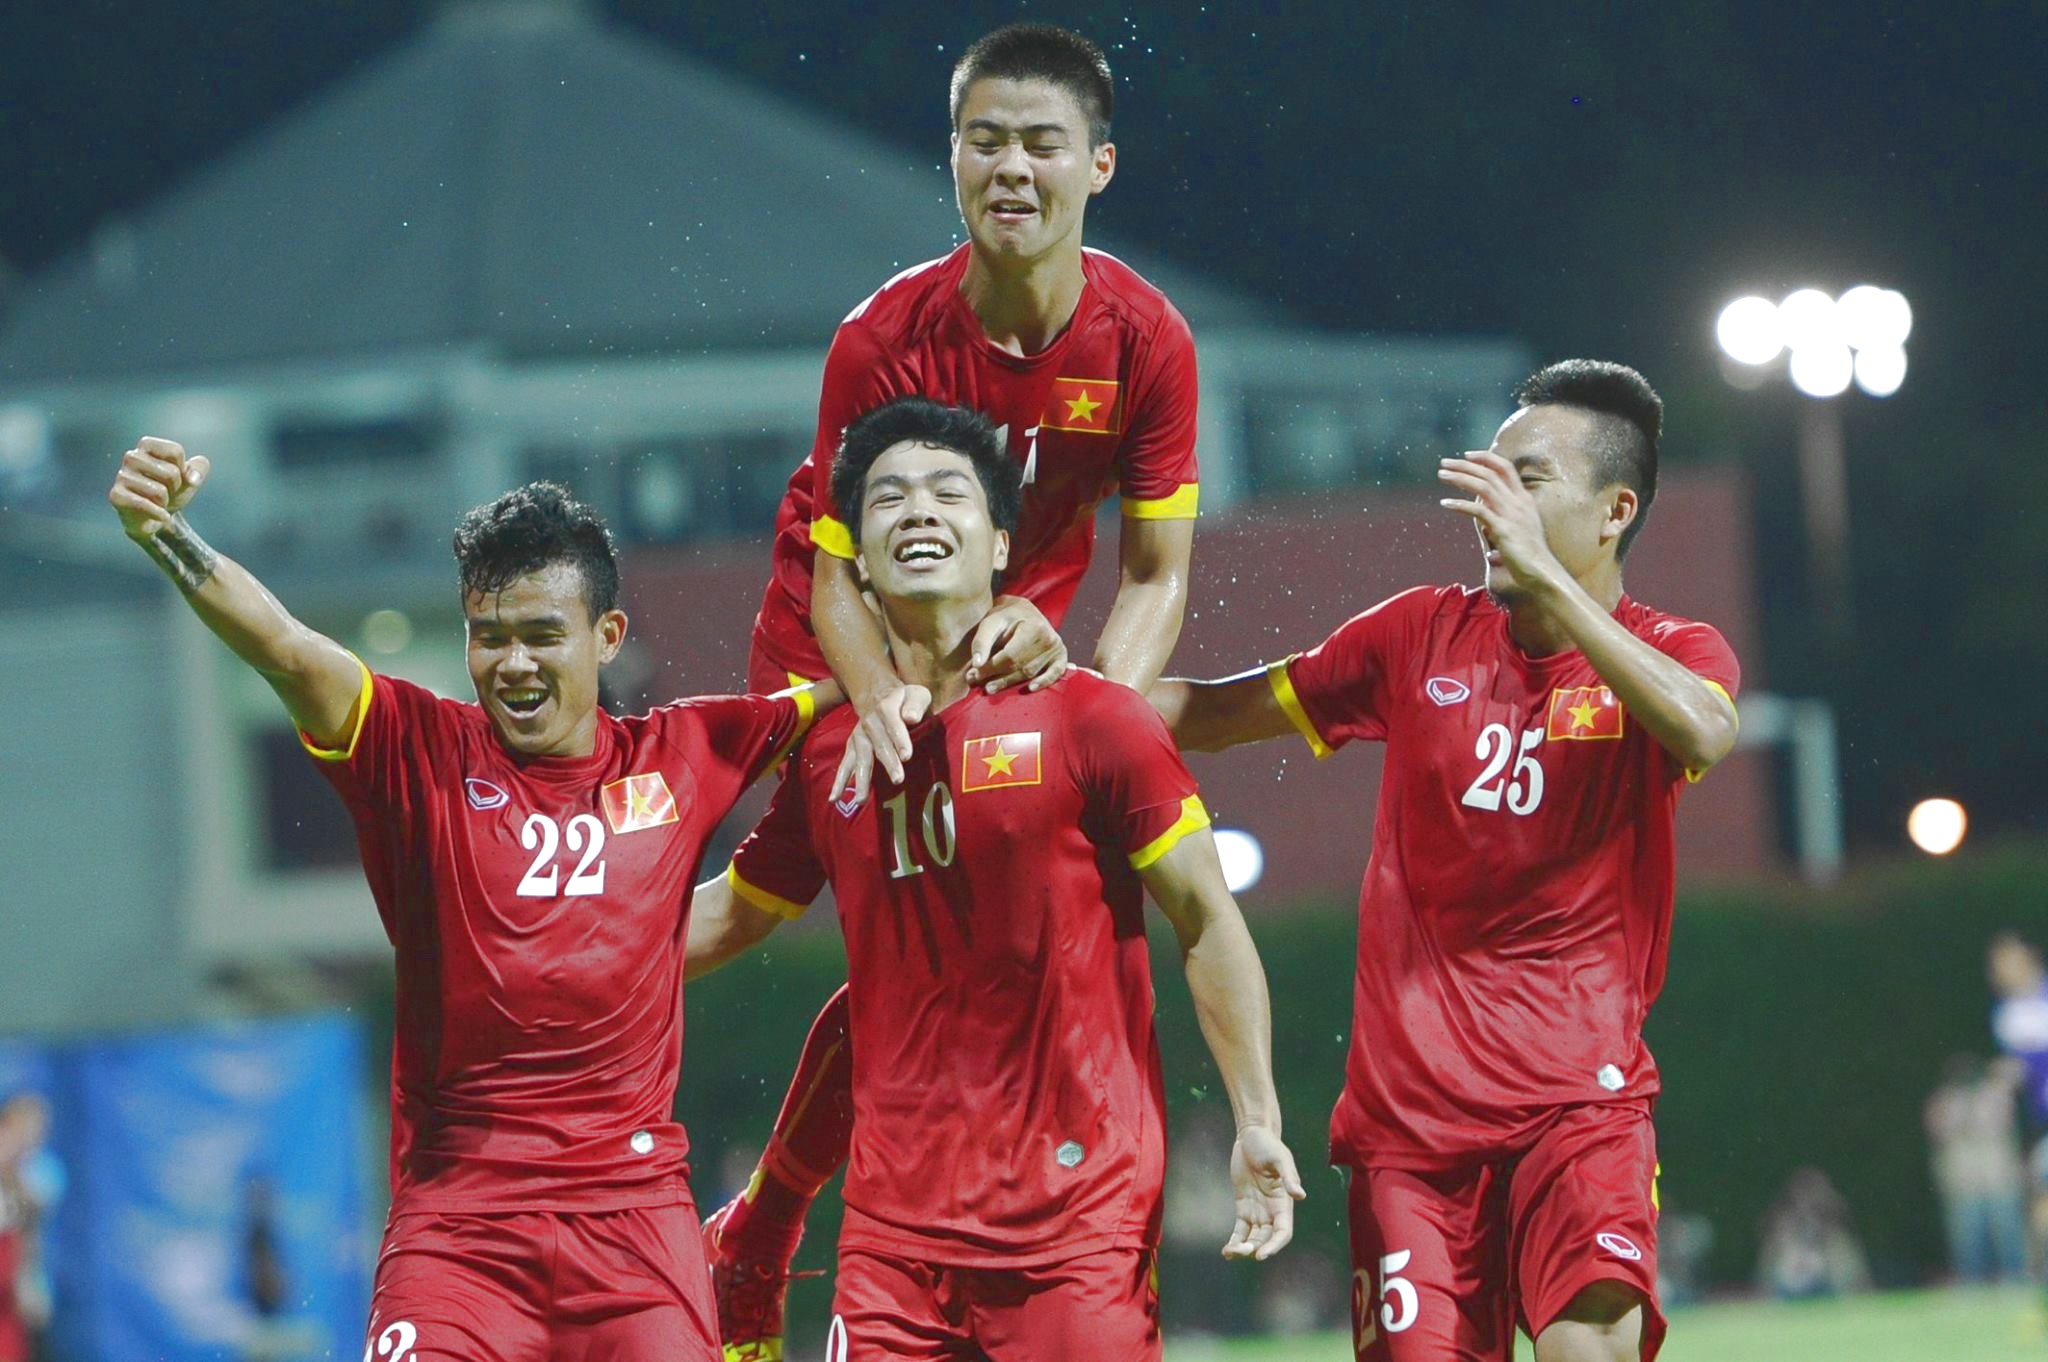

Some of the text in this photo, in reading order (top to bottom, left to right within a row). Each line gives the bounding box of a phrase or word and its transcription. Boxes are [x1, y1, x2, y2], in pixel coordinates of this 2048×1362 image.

[1461, 722, 1545, 816] 25
[516, 813, 606, 897] 22
[882, 780, 956, 879] 10
[363, 1320, 418, 1362] 2
[1353, 1249, 1419, 1352] 25
